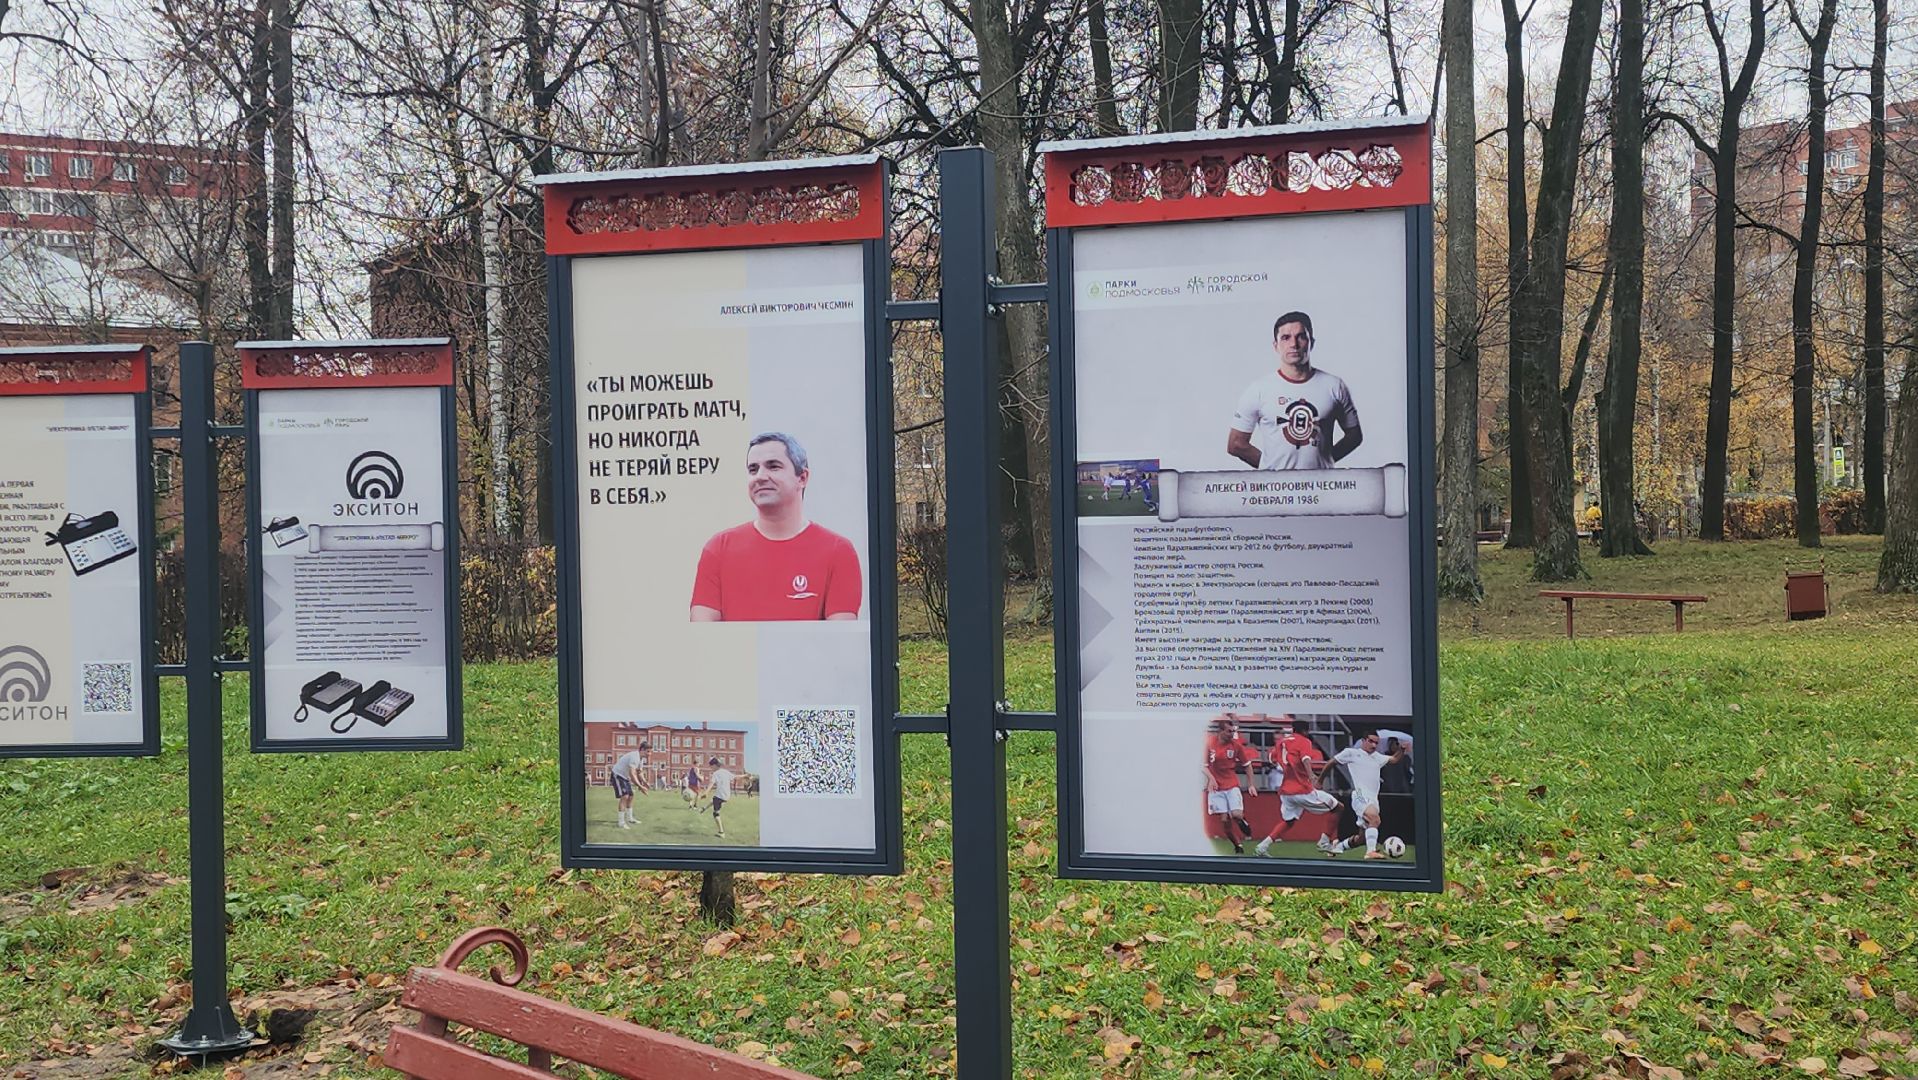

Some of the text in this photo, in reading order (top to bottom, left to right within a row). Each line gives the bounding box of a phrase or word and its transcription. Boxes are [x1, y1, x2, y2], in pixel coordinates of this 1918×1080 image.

[1207, 272, 1268, 283] ГОРОДСКОЙ
[1105, 280, 1137, 288] ПАРКИ
[1208, 284, 1233, 293] ПАРК
[1105, 287, 1180, 298] ПОДМОСКОВЬЯ
[720, 300, 854, 315] АЛЕКСЕЙ ВИКТОРОВИЧ ЧЕСМИН
[586, 373, 713, 393] «ТЫ МОЖЕШЬ
[587, 400, 746, 421] ПРОИГРАТЬ МАТЧ,
[589, 429, 700, 451] НО НИКОГДА
[589, 454, 720, 477] НЕ ТЕРЯЙ ВЕРУ
[1205, 480, 1356, 493] АЛЕКСЕЙ ВИКТОРОВИЧ ЧЕСМИН
[590, 487, 667, 505] В СЕБЯ.»
[1241, 495, 1319, 506] 7 ФЕВРАЛЯ 1986
[333, 502, 419, 516] ЭКСИТОН
[1307, 541, 1353, 550] двукратный
[23, 558, 63, 566] БЛАГОДАРЯ
[1134, 562, 1182, 571] Заслуженный
[1134, 599, 1179, 607] Серебряный
[1235, 599, 1297, 607] Паралимпийских
[1135, 617, 1182, 626] Трёхкратный
[1177, 646, 1222, 654] спортивные
[1292, 645, 1356, 654] Паралимпийских
[1273, 692, 1294, 700] детей
